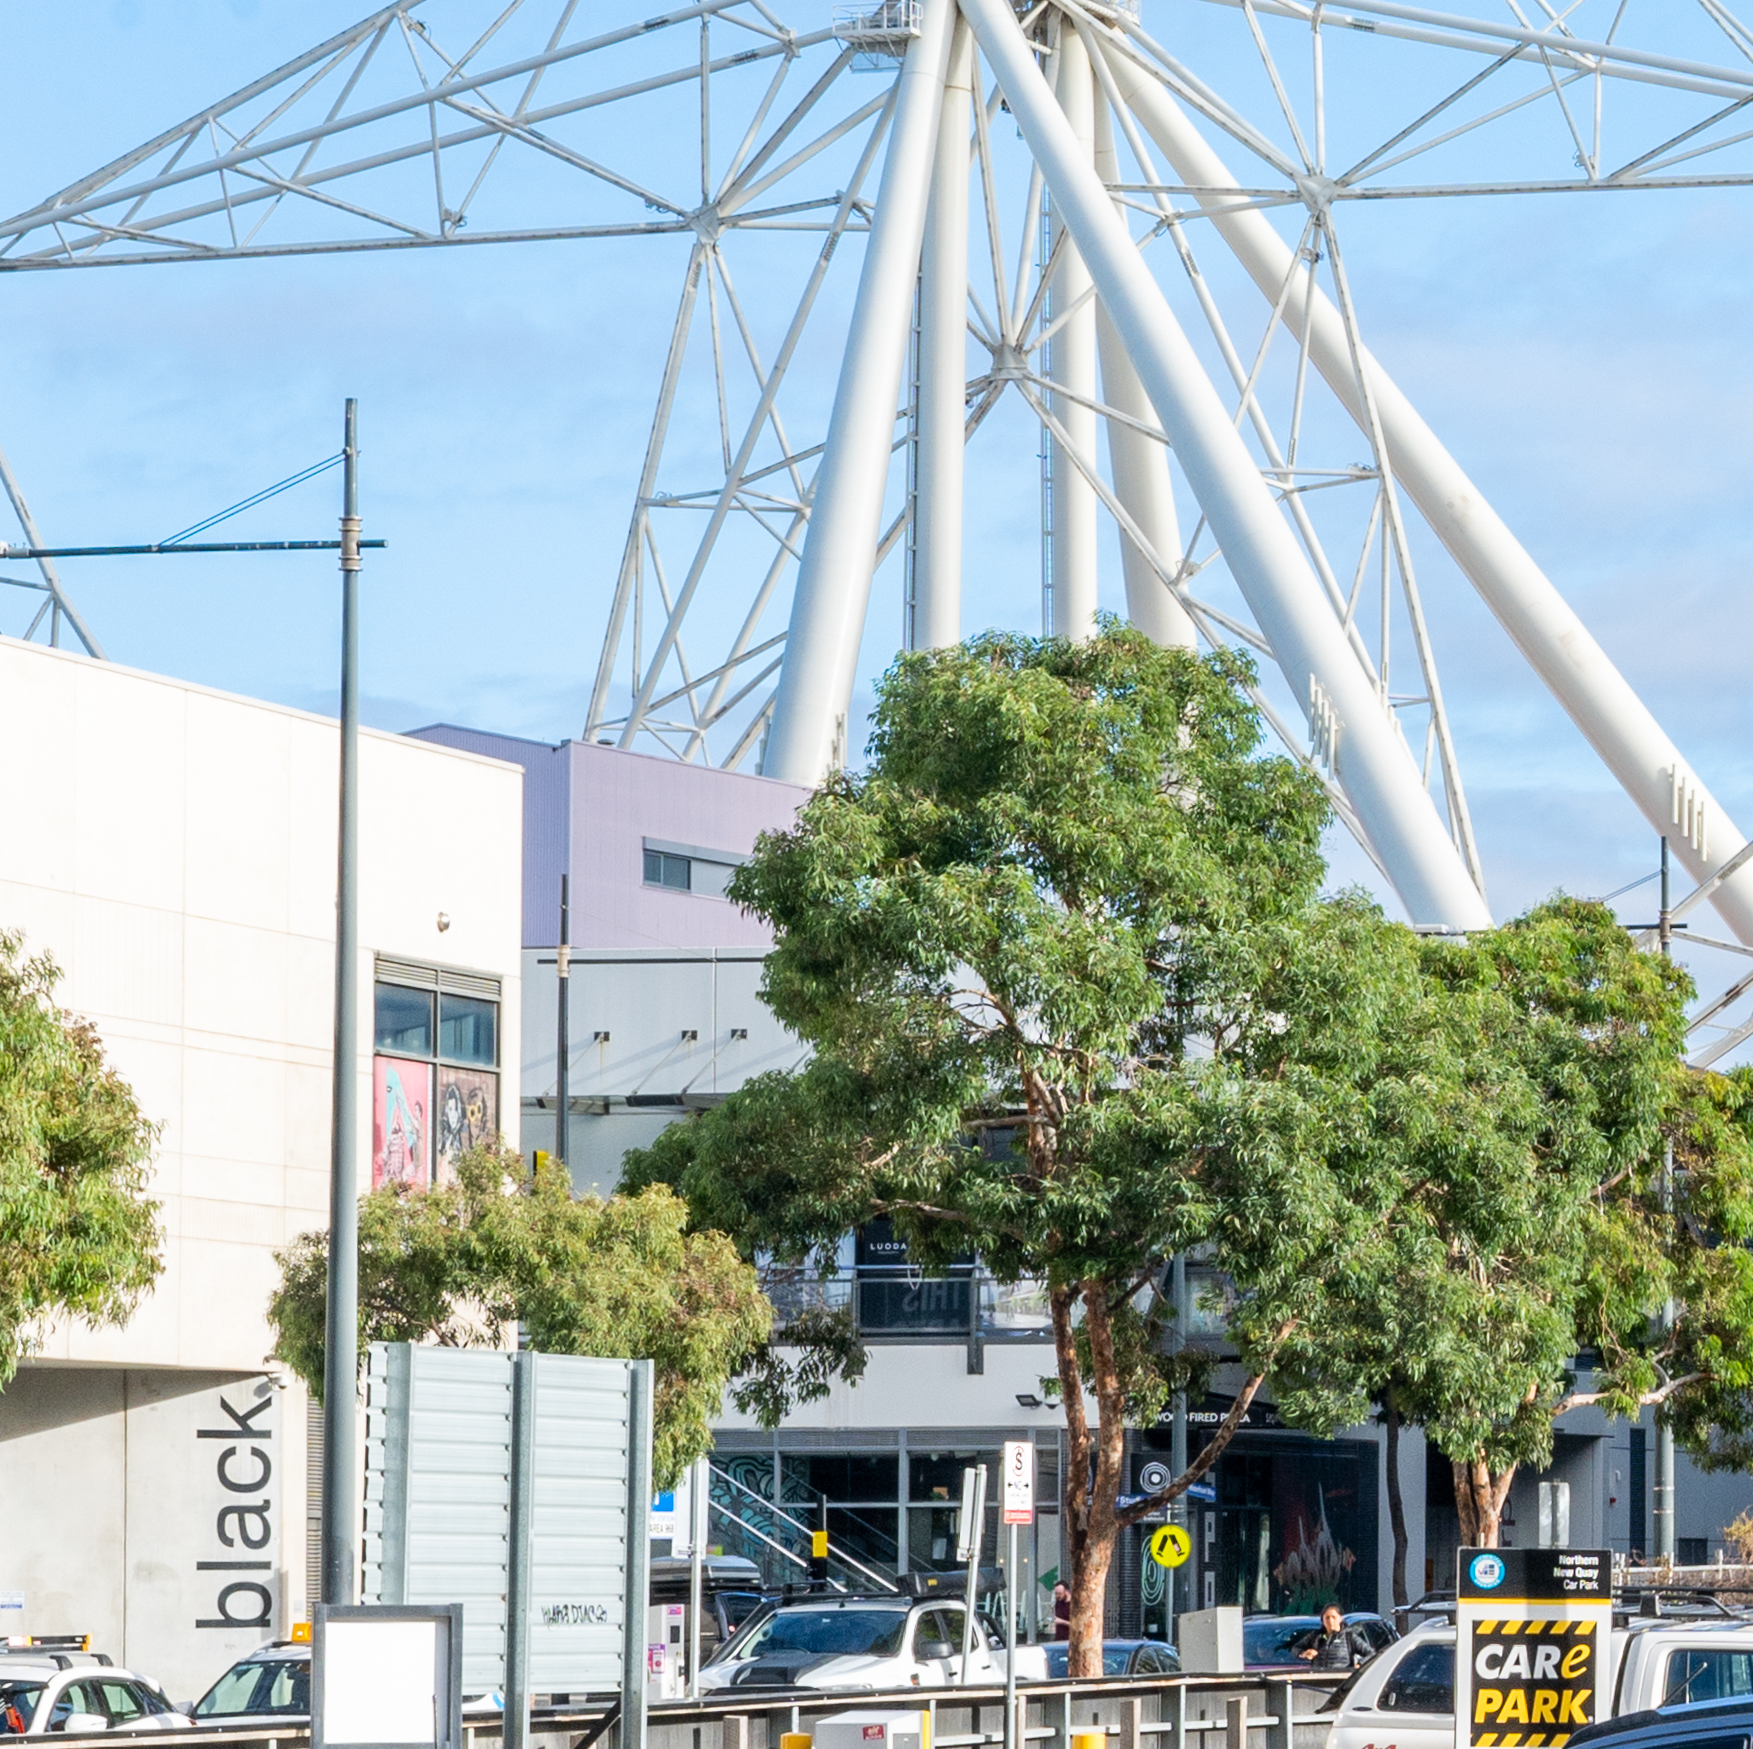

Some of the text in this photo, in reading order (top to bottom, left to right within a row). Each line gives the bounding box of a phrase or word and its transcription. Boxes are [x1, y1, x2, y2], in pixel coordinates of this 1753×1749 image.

[1189, 1412, 1218, 1423] FIRED
[196, 1395, 273, 1630] black
[1559, 1555, 1599, 1566] Northern
[1553, 1567, 1599, 1580] New Quay
[1563, 1579, 1599, 1590] Car Park
[1474, 1688, 1593, 1724] PARK
